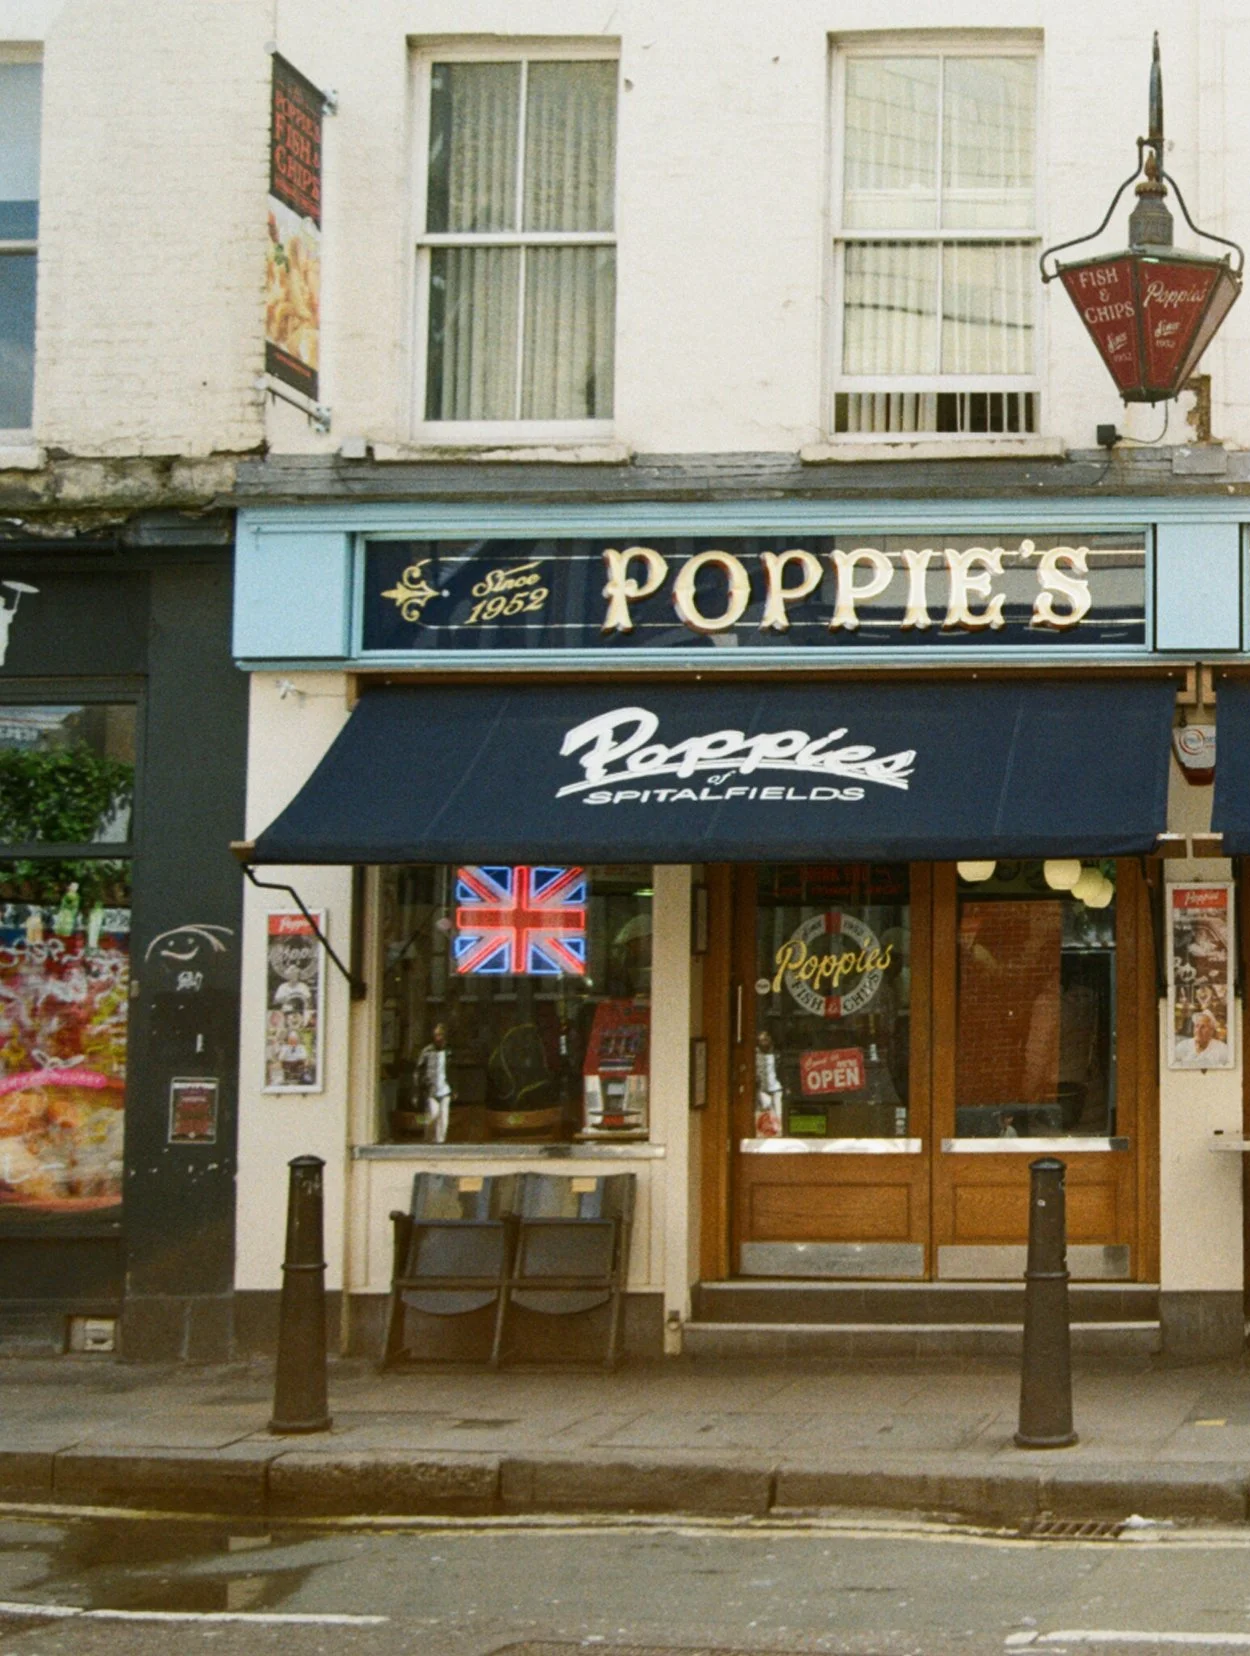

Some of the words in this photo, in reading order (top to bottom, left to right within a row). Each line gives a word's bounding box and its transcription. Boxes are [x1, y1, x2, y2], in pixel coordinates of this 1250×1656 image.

[274, 111, 312, 165] FISH
[275, 145, 320, 201] CHIPS
[1078, 267, 1118, 289] FISH
[1099, 290, 1110, 302] &
[1143, 280, 1206, 308] Poppies
[1084, 301, 1135, 324] CHIPS
[472, 560, 544, 598] Since
[602, 539, 1092, 634] POPPIE'S
[464, 588, 549, 625] 1952
[558, 706, 916, 790] Poppies
[583, 786, 865, 804] SPITALFIELDS
[707, 770, 736, 785] of
[772, 938, 893, 993] Poppies
[792, 981, 823, 1010] FISH
[843, 972, 880, 1011] CHIPS
[807, 1066, 860, 1090] OPEN
